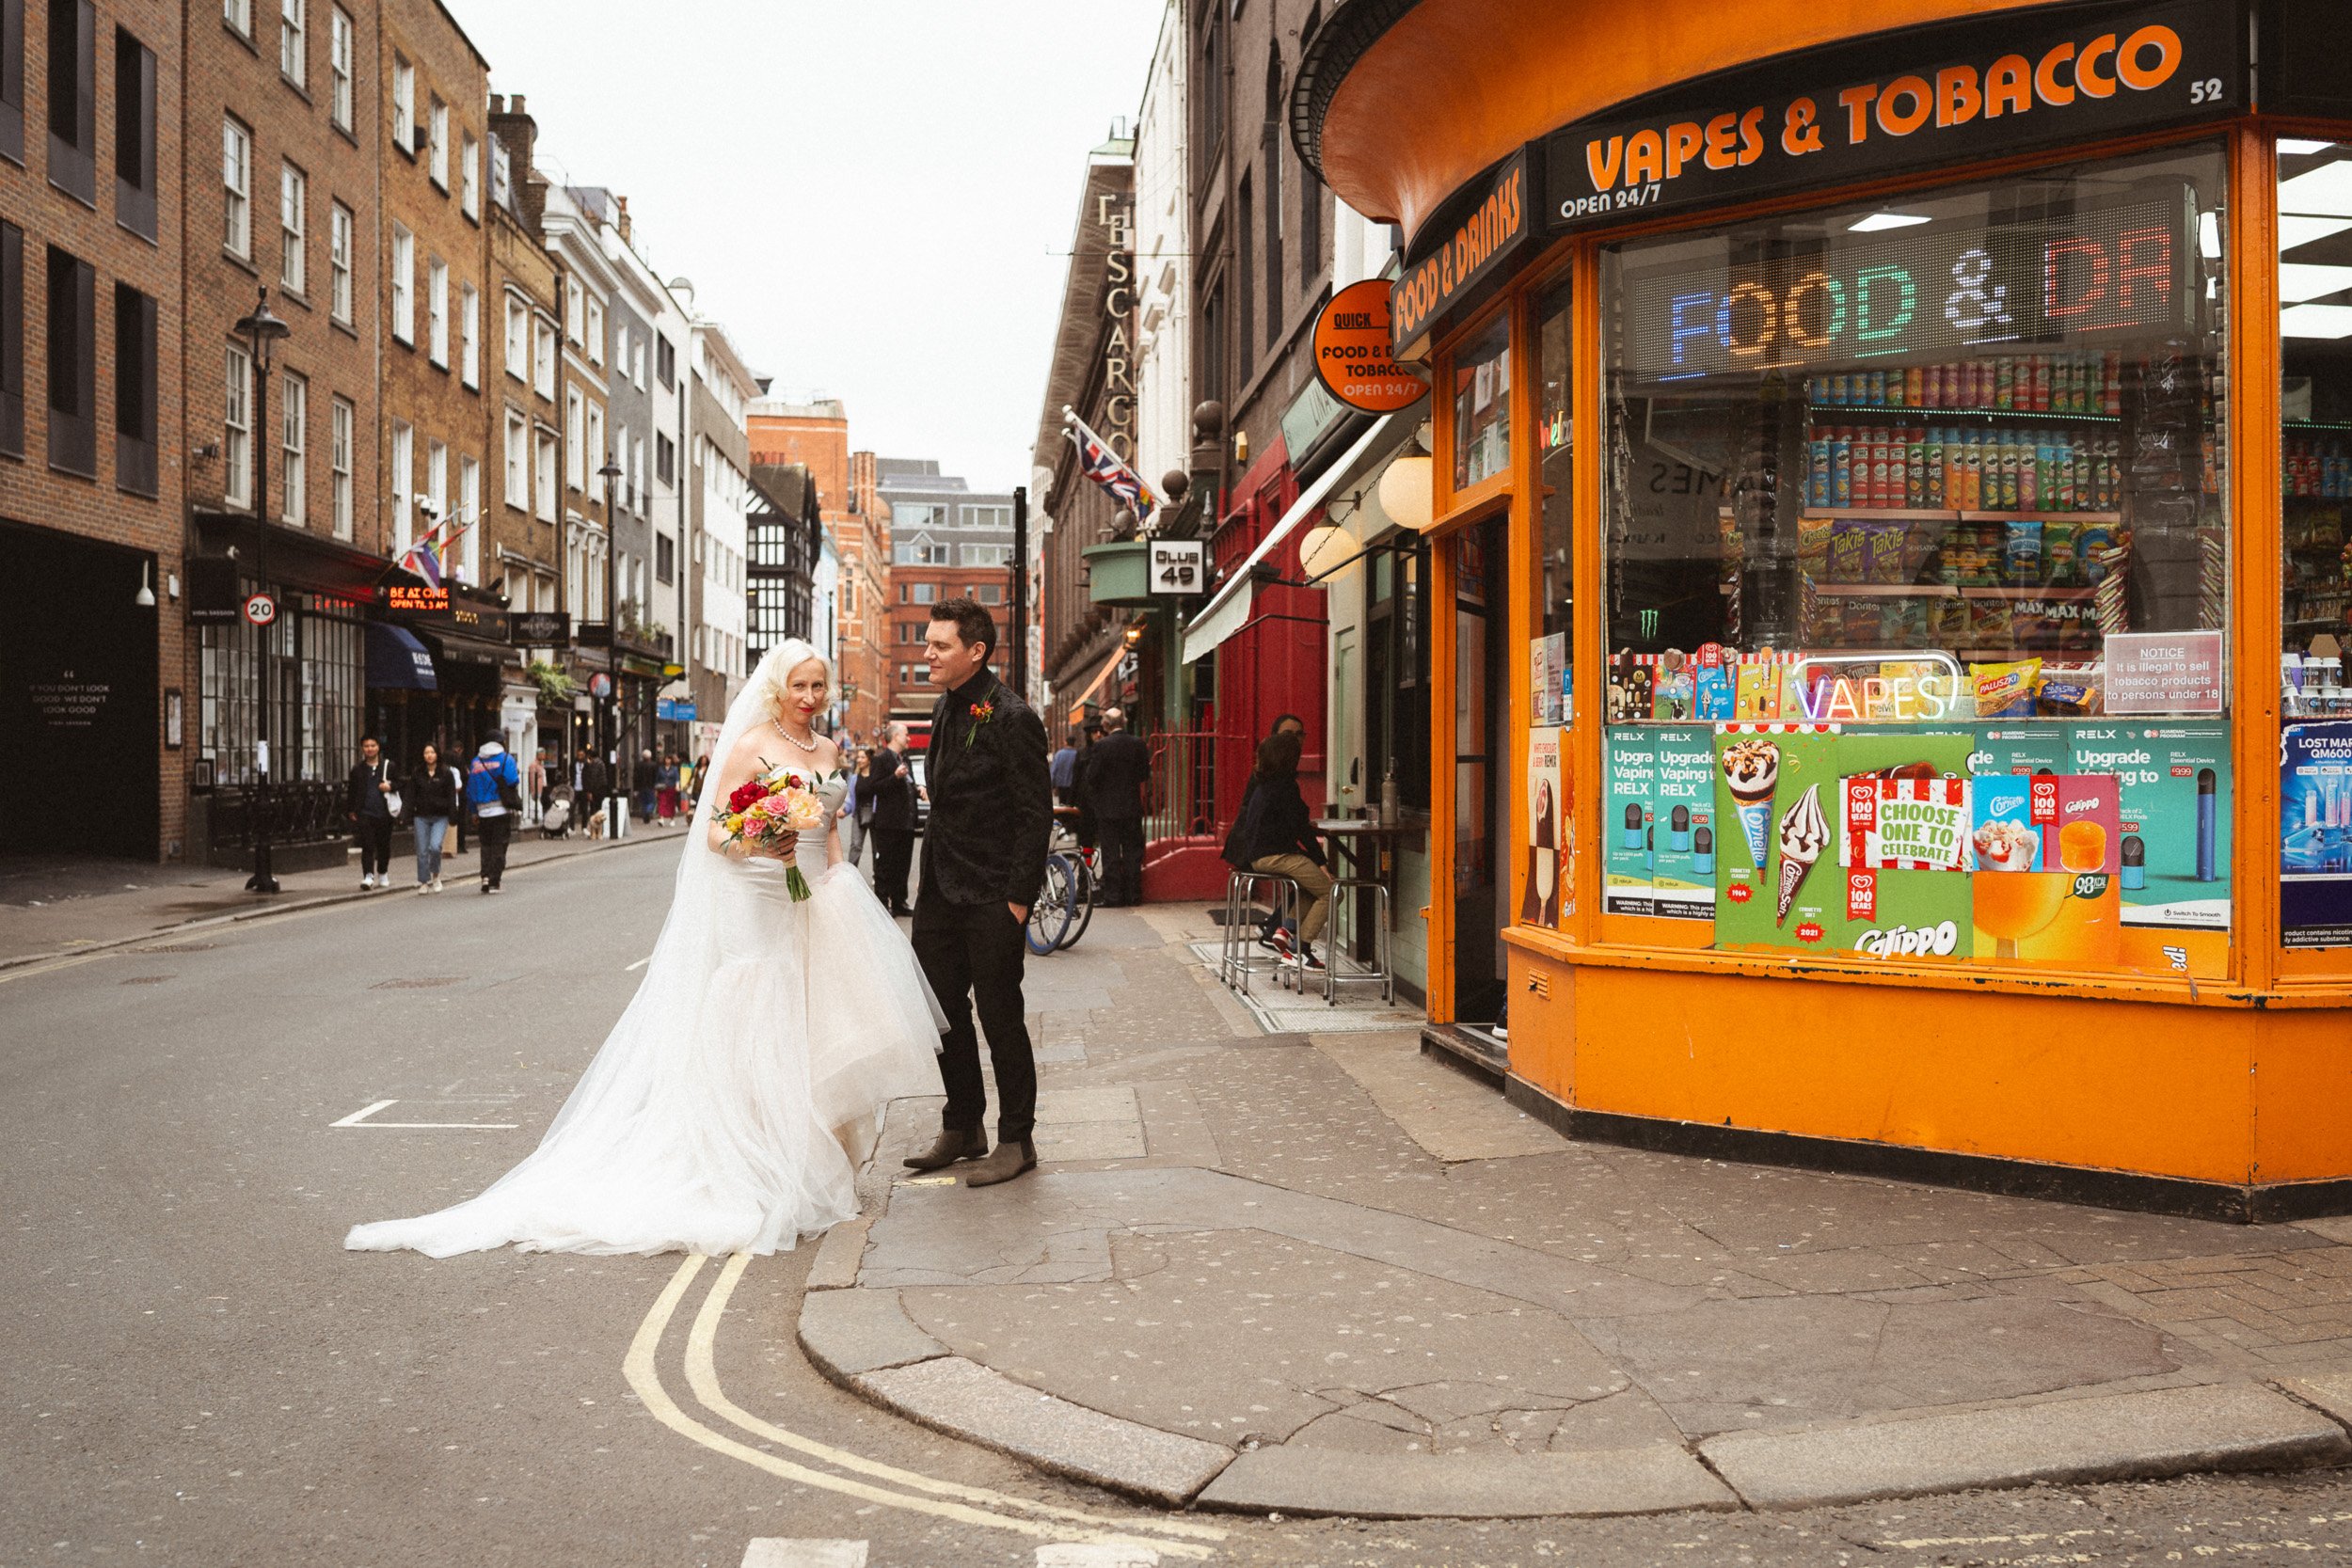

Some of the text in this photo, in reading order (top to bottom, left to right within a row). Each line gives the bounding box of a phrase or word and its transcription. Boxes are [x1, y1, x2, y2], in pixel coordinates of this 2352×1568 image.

[2190, 78, 2223, 104] 52
[1586, 24, 2182, 192] VAPES & TOBACCO
[1560, 184, 1661, 219] OPEN 24/7
[1396, 166, 1520, 343] FOOD & DRINKS
[1671, 264, 1917, 365] FOOD
[1945, 248, 2013, 329] &
[1333, 312, 1371, 327] QUICK
[1322, 346, 1368, 358] FOOD
[1372, 345, 1381, 358] &
[1343, 383, 1419, 396] OPEN 24/7
[1832, 530, 1866, 559] Takis
[1870, 530, 1904, 559] Takis
[1156, 550, 1199, 564] CLUB
[1161, 566, 1194, 585] 49
[389, 587, 405, 598] BE
[407, 587, 421, 598] AT
[249, 603, 271, 616] 20
[389, 599, 413, 609] OPEN
[1849, 600, 1880, 611] Doritos
[2014, 602, 2044, 614] MAX
[2045, 605, 2079, 619] MAX
[2140, 647, 2185, 657] NOTICE
[2117, 661, 2209, 673] It is illegal to sell
[2115, 675, 2211, 688] tobacco products
[1794, 675, 1945, 721] VAPES
[2107, 689, 2218, 702] to persons under 18
[43, 705, 97, 714] LOOK GOOD
[1660, 733, 1692, 741] RELX
[2075, 729, 2117, 739] RELX
[2298, 737, 2328, 748] LOST
[2076, 749, 2152, 768] Upgrade
[1660, 767, 1707, 784] Vaping
[2139, 768, 2159, 783] to
[1613, 783, 1649, 795] RELX
[1660, 784, 1697, 797] RELX
[1851, 799, 1872, 813] 100
[2033, 796, 2056, 808] 100
[1851, 813, 1872, 821] YEARS
[1880, 803, 1960, 827] CHOOSE
[2034, 808, 2056, 816] YEARS
[1882, 823, 1954, 847] ONE TO
[1882, 843, 1952, 863] CELEBRATE
[2075, 876, 2094, 895] 98
[1851, 888, 1872, 901] 100
[1851, 902, 1872, 911] YEARS
[1853, 920, 1958, 959] Calippo
